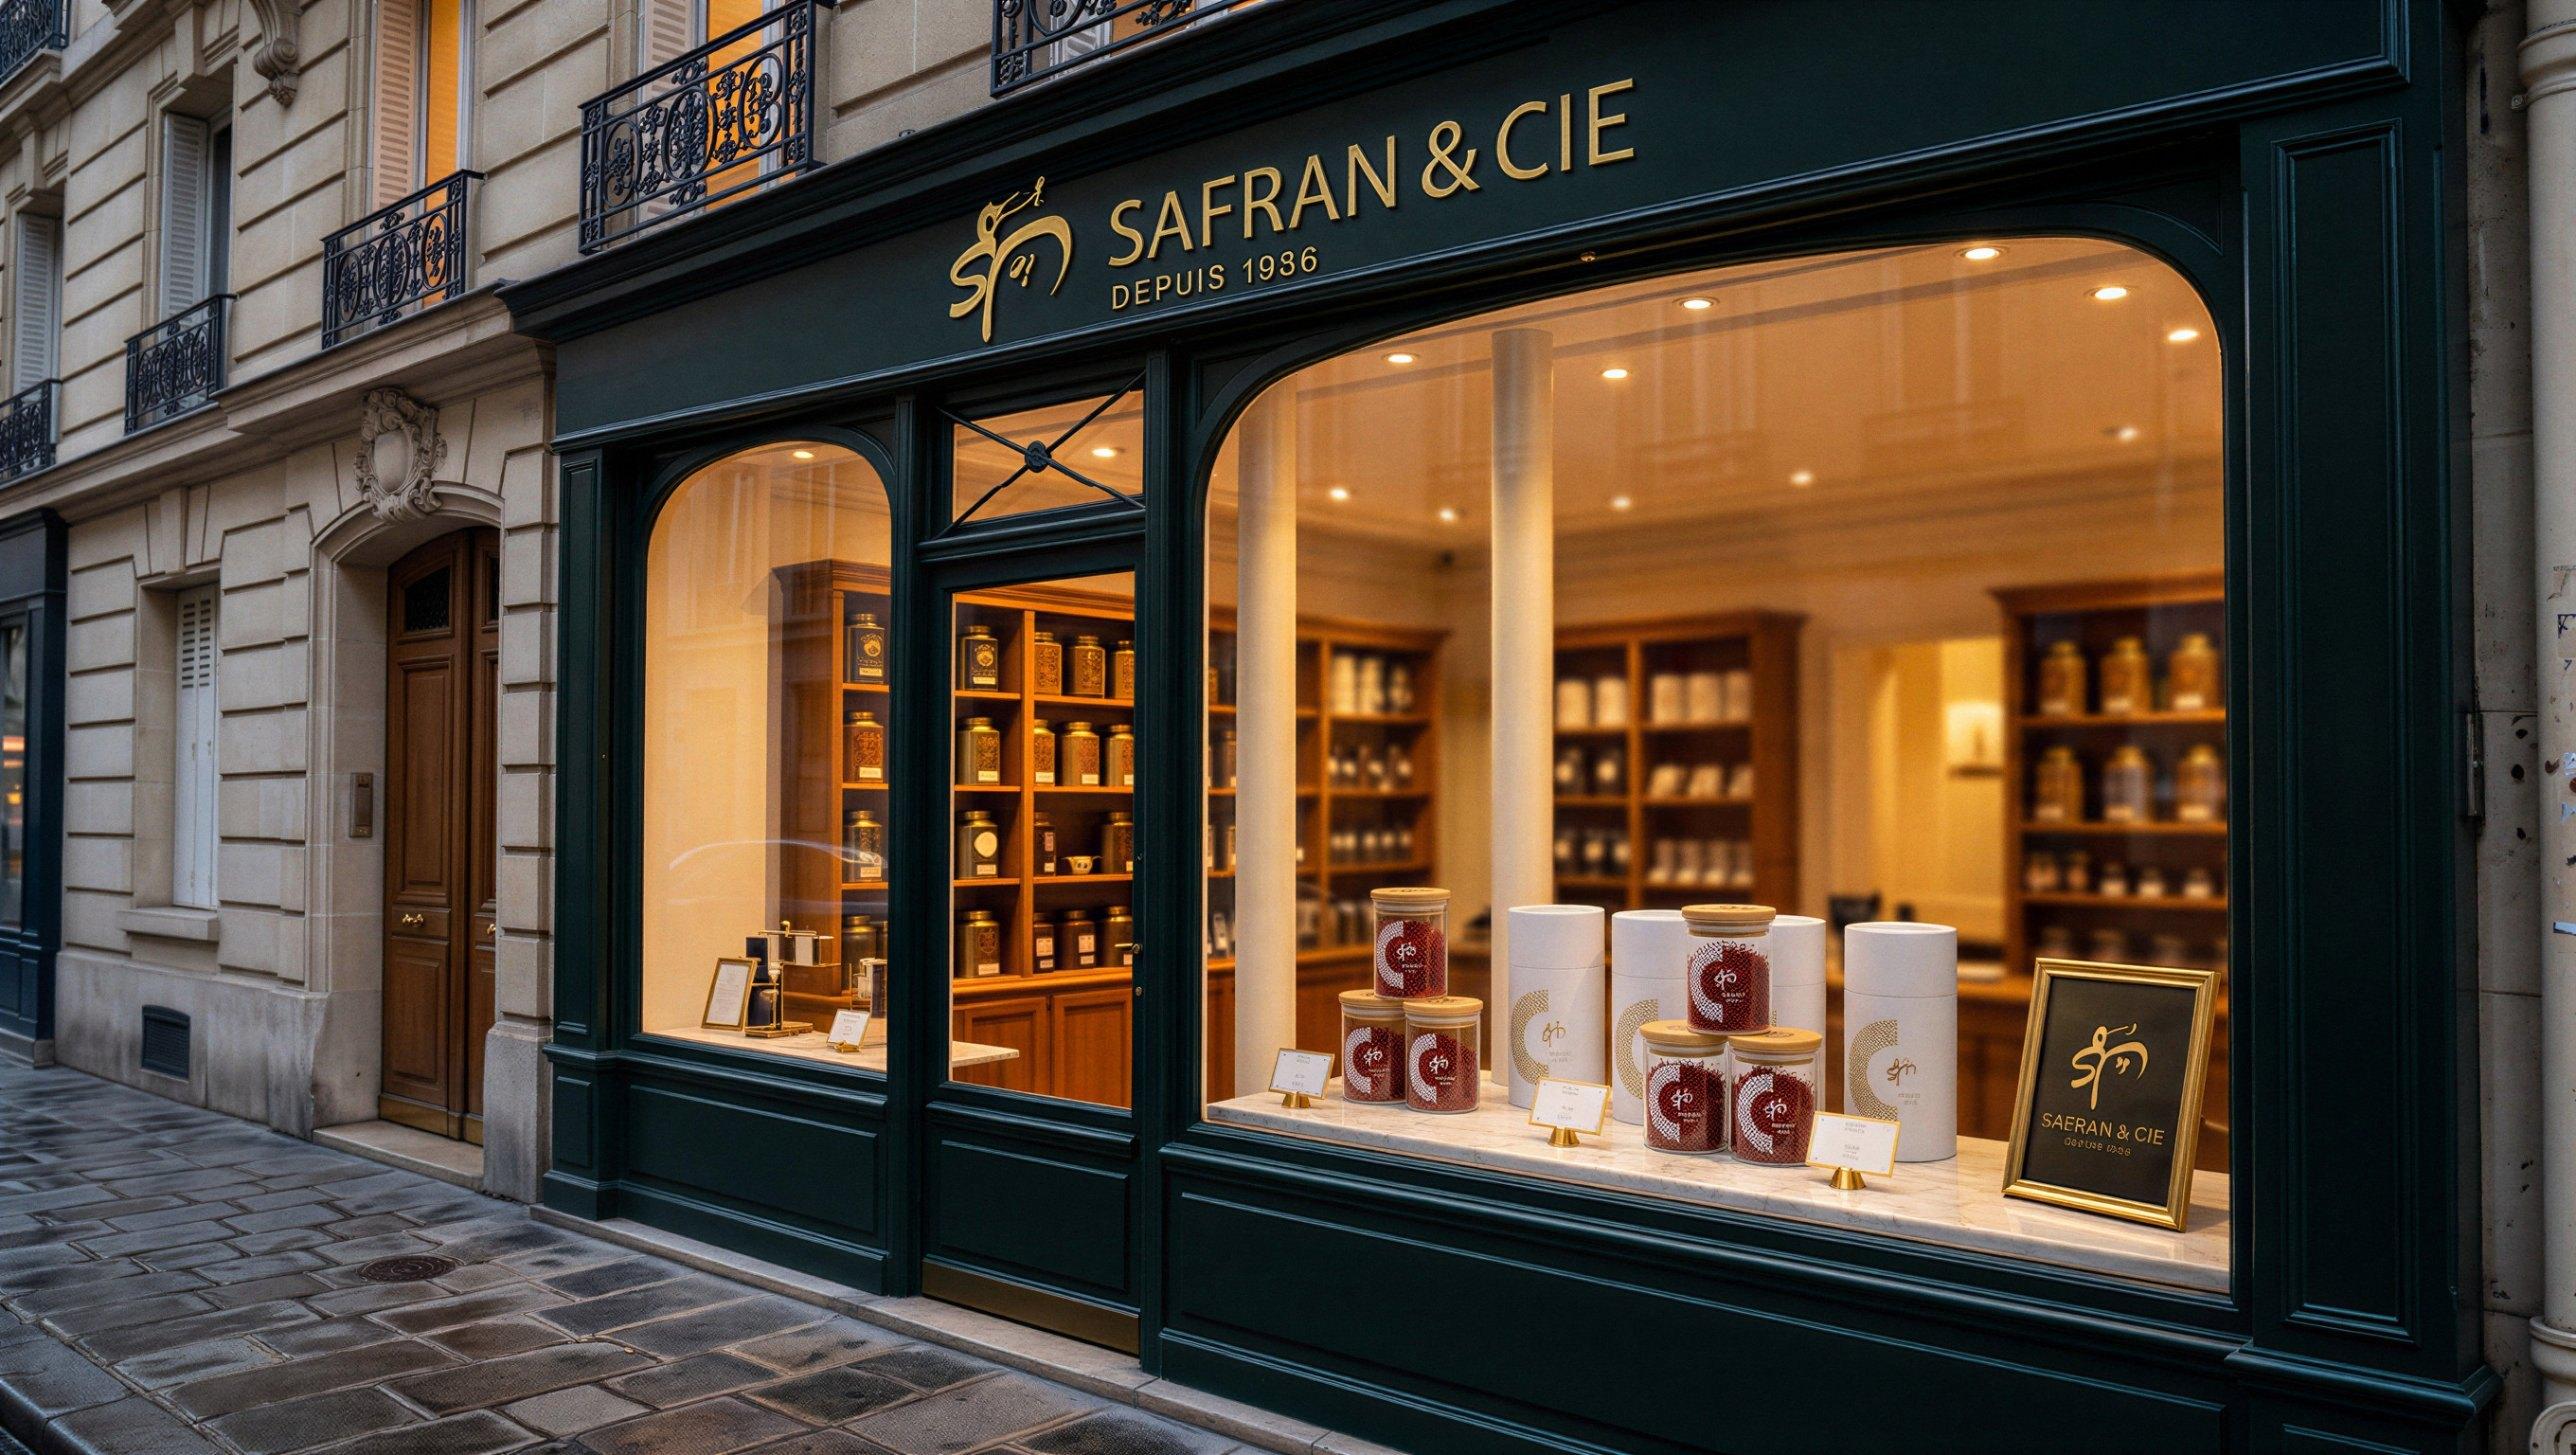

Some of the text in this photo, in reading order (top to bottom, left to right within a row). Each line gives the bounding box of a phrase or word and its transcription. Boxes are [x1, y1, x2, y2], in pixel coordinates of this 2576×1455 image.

[1108, 135, 1397, 267] SAFRAN
[1421, 120, 1481, 199] &
[1496, 78, 1636, 181] CIE
[1112, 263, 1226, 311] DEPUIS
[2116, 1123, 2130, 1141] &
[2134, 1126, 2165, 1146] CIE
